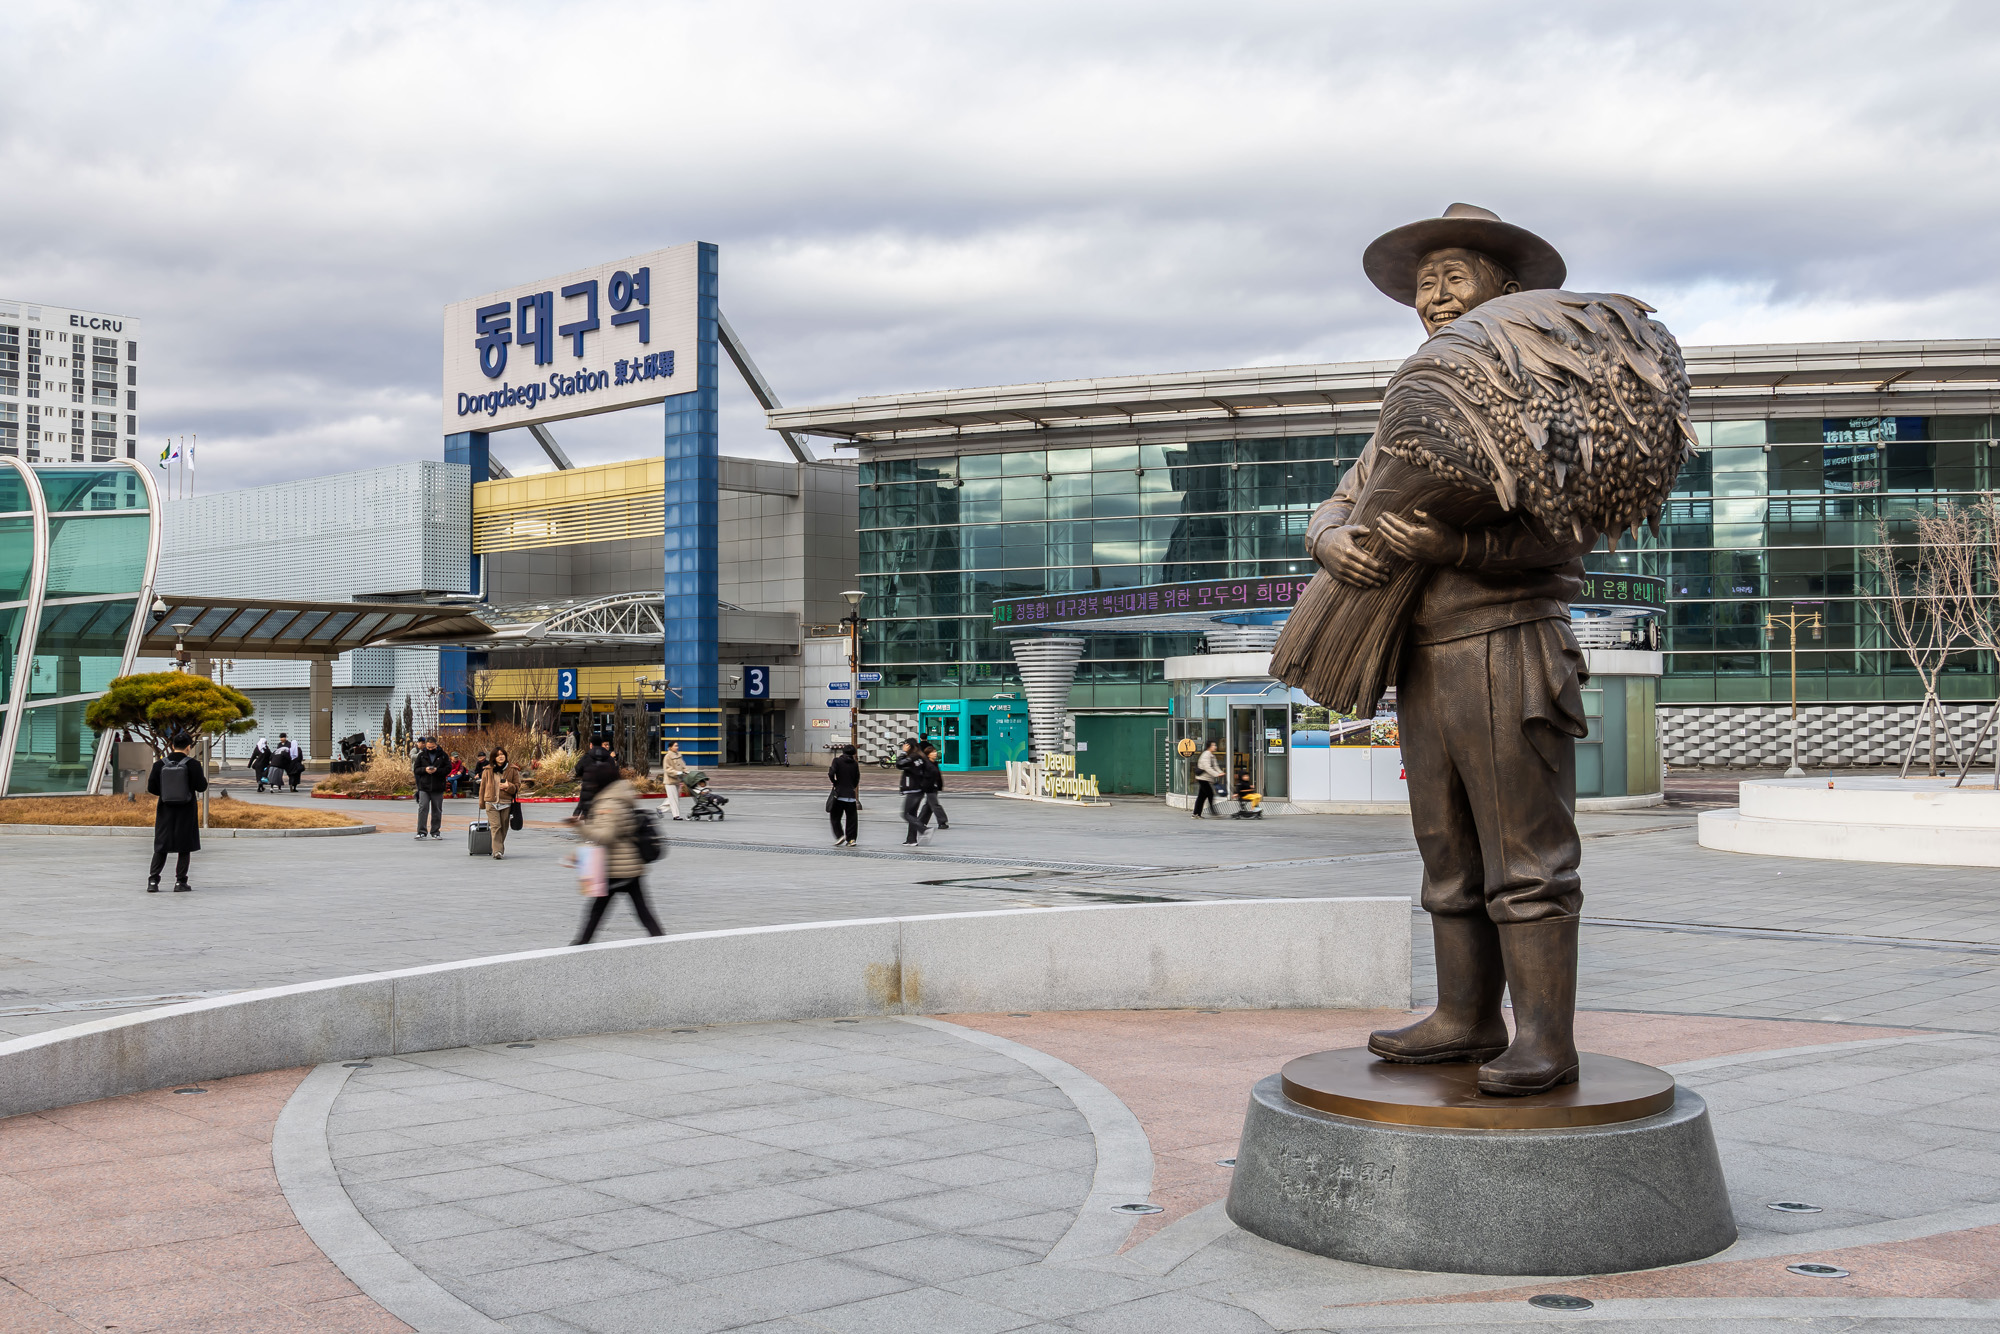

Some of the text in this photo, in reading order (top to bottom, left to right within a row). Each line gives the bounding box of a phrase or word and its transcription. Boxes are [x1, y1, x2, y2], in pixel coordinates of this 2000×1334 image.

[70, 314, 122, 332] ELCRU
[475, 266, 650, 378] 동대구역
[457, 382, 546, 416] Dongdaegu
[549, 367, 609, 399] Station
[1016, 601, 1049, 621] 정통합!
[1056, 597, 1098, 617] 대구경북
[1102, 592, 1159, 613] 백년대계를
[1164, 589, 1191, 608] 위한
[1198, 584, 1247, 606] 모두의
[1602, 580, 1628, 600] 운행
[1633, 582, 1654, 604] 안내]
[562, 671, 573, 697] 3
[750, 669, 764, 695] 3
[1044, 751, 1075, 777] Daegu
[1005, 760, 1043, 797] VISIT
[1044, 772, 1100, 801] Gyeongbuk
